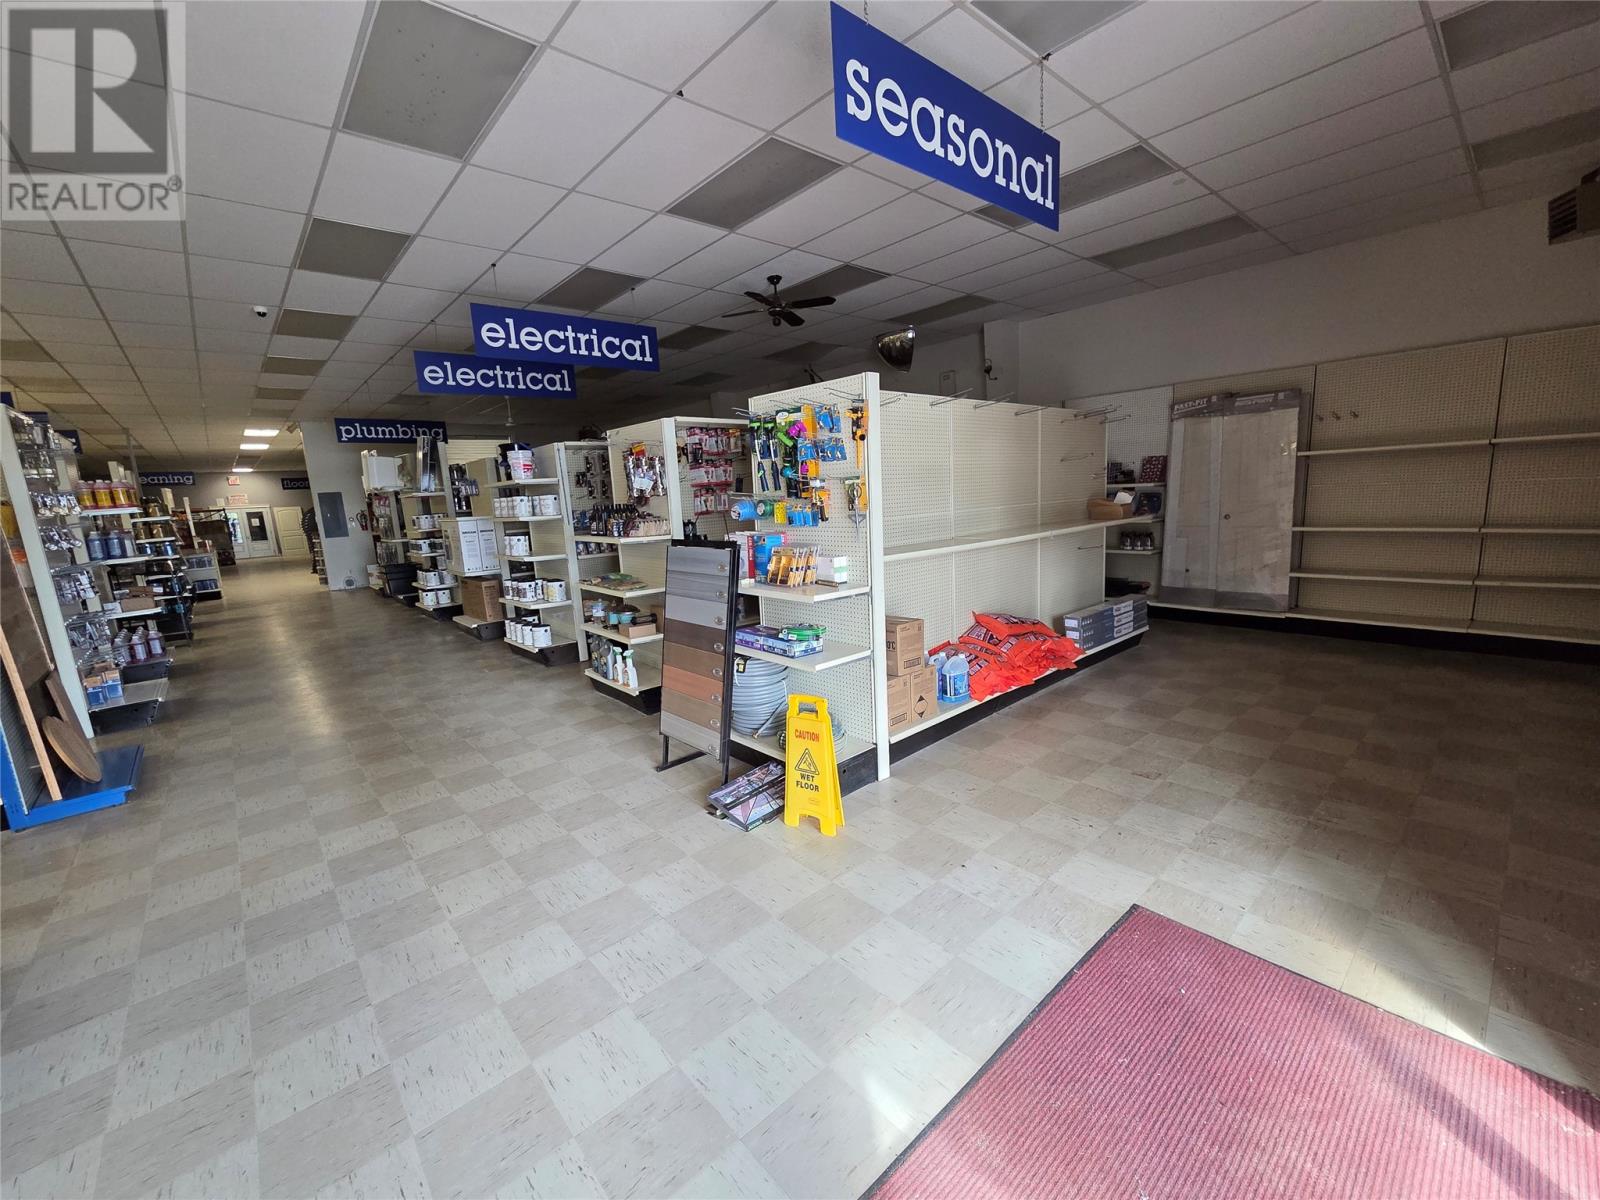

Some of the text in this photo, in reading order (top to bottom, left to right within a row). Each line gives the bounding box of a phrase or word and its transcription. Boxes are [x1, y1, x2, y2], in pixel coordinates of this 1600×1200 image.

[845, 58, 1055, 210] seasonal
[480, 318, 653, 362] electrical
[423, 362, 572, 392] electrical
[339, 423, 444, 442] plumbing
[794, 729, 820, 742] CAUTION
[795, 780, 820, 793] FLOOR
[800, 773, 815, 783] WET
